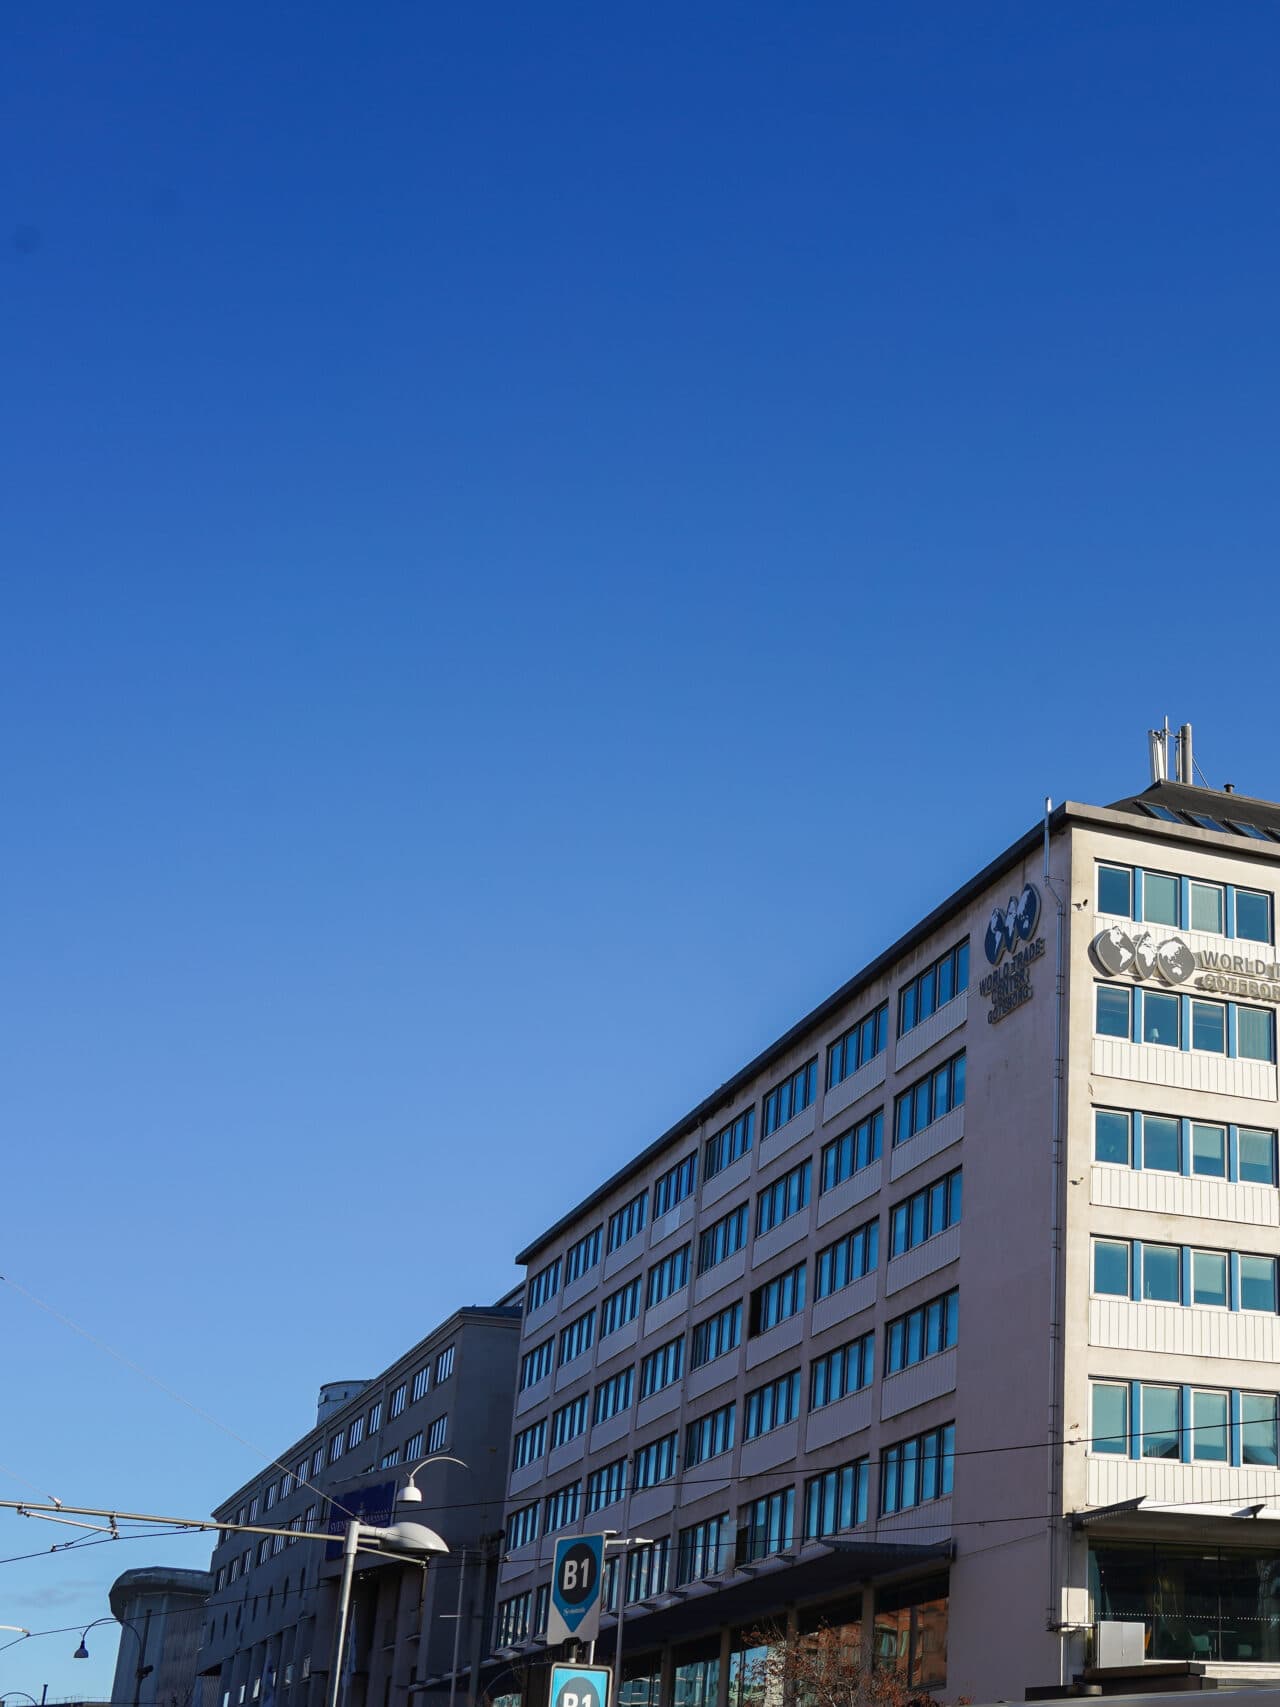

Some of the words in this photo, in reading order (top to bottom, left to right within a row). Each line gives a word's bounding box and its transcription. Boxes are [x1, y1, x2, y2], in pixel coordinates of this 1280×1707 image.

[979, 961, 1009, 996] WORLD
[1012, 941, 1042, 972] TRADE
[1204, 950, 1266, 975] WORLD
[563, 1557, 590, 1590] B1
